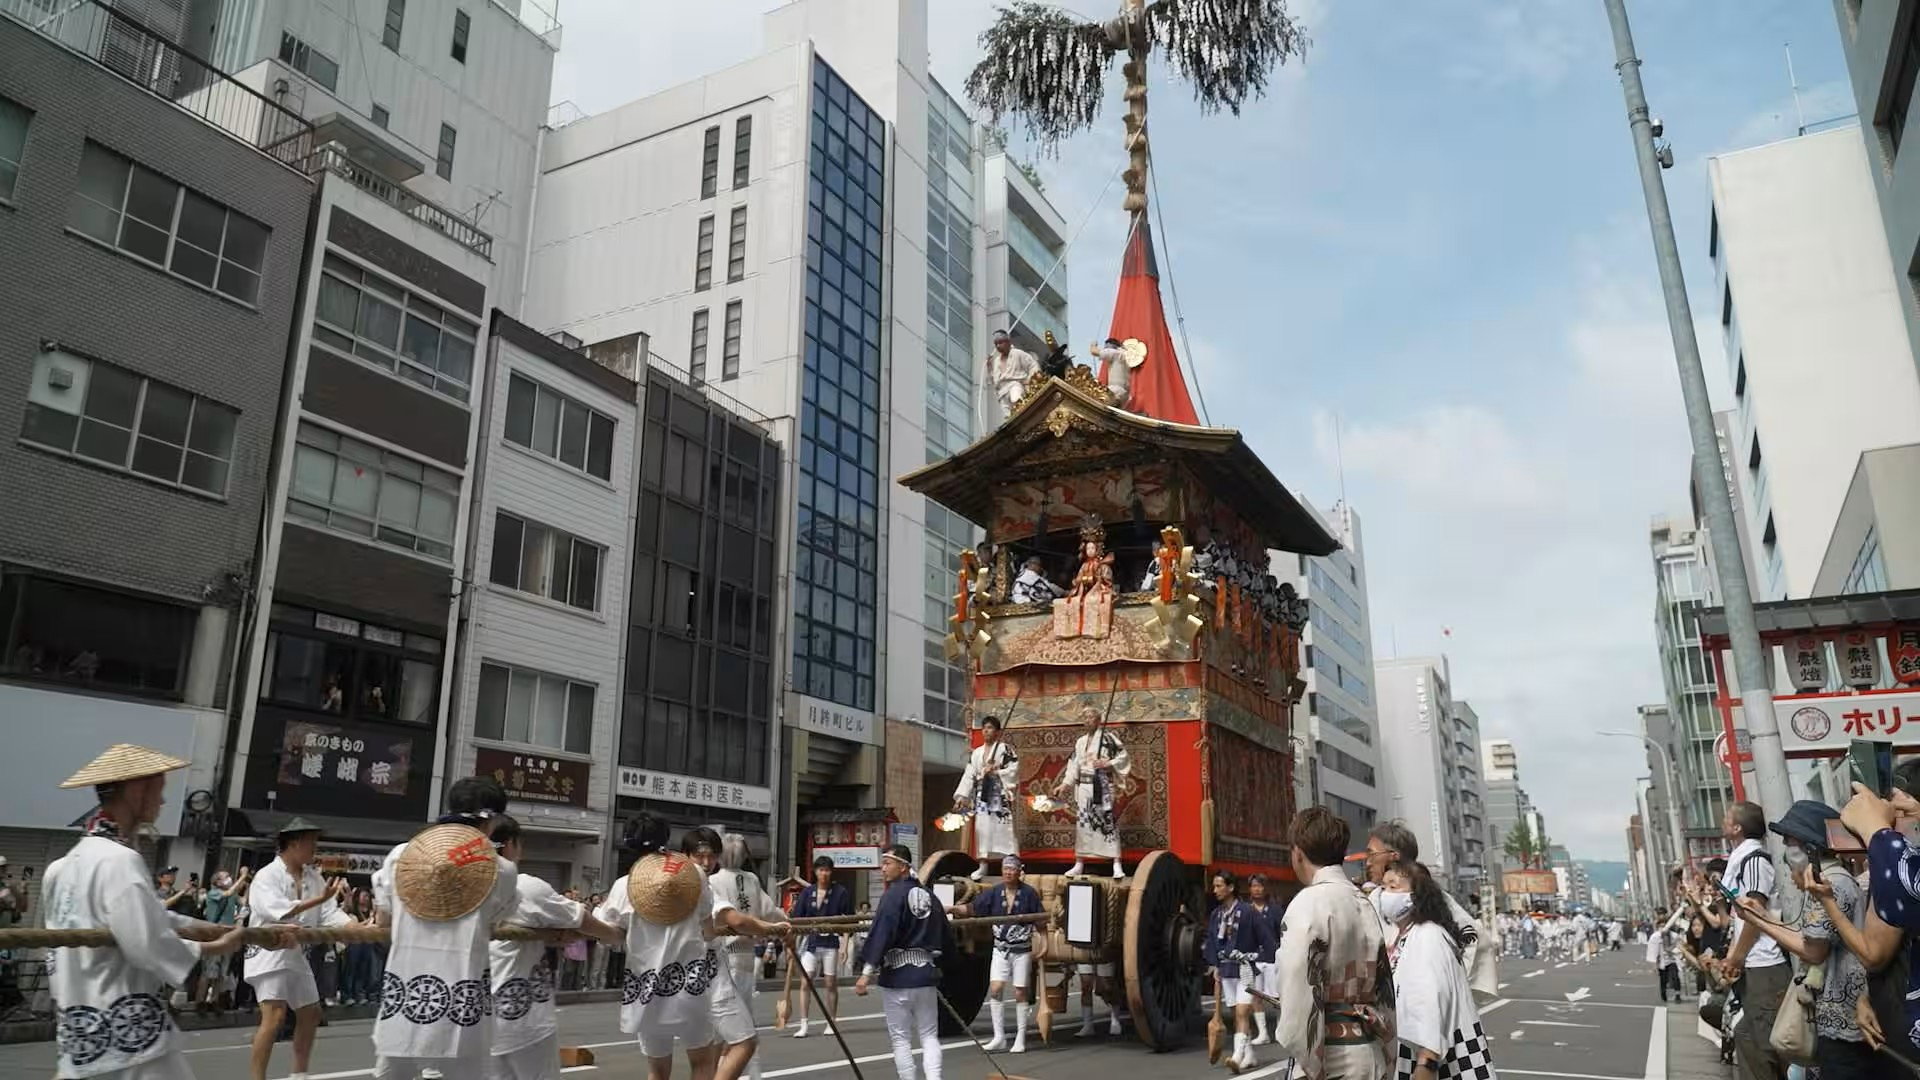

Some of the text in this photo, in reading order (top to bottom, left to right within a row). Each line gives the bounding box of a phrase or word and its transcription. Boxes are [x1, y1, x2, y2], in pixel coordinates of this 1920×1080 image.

[651, 775, 743, 806] 熊本歯科医院
